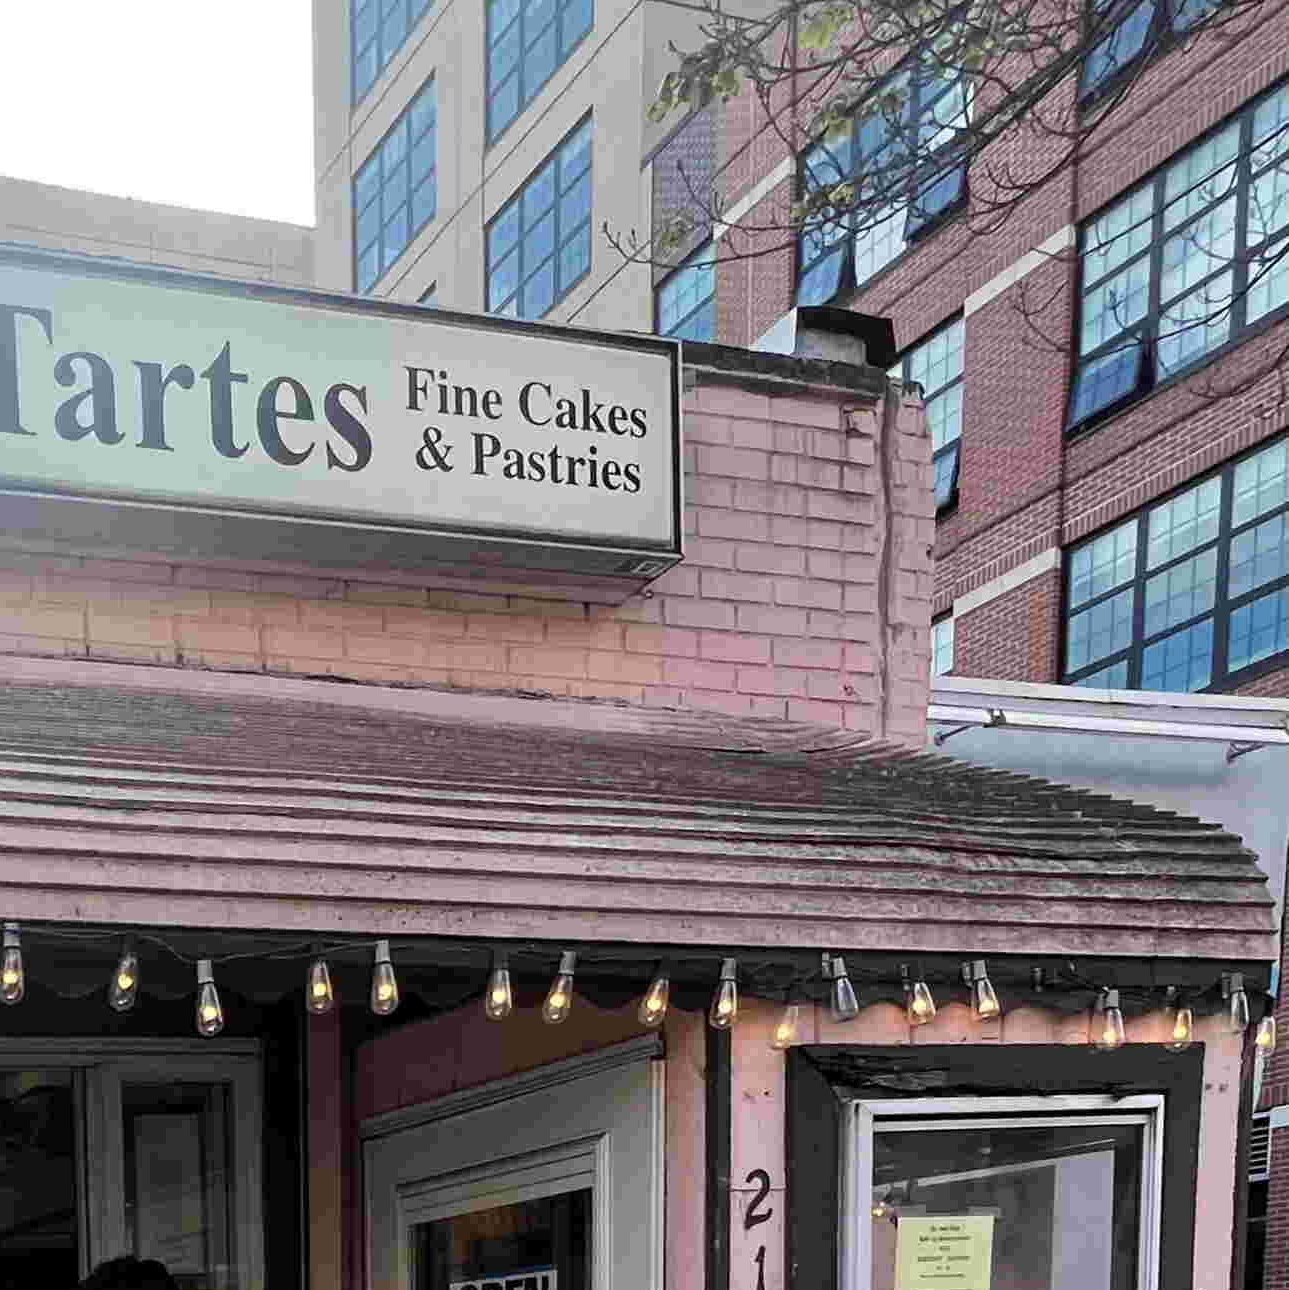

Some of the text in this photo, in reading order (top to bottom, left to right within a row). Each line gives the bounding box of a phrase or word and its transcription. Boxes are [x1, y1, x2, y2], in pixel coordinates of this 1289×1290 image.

[403, 366, 647, 438] Fine Cakes
[415, 426, 641, 493] & Pastries
